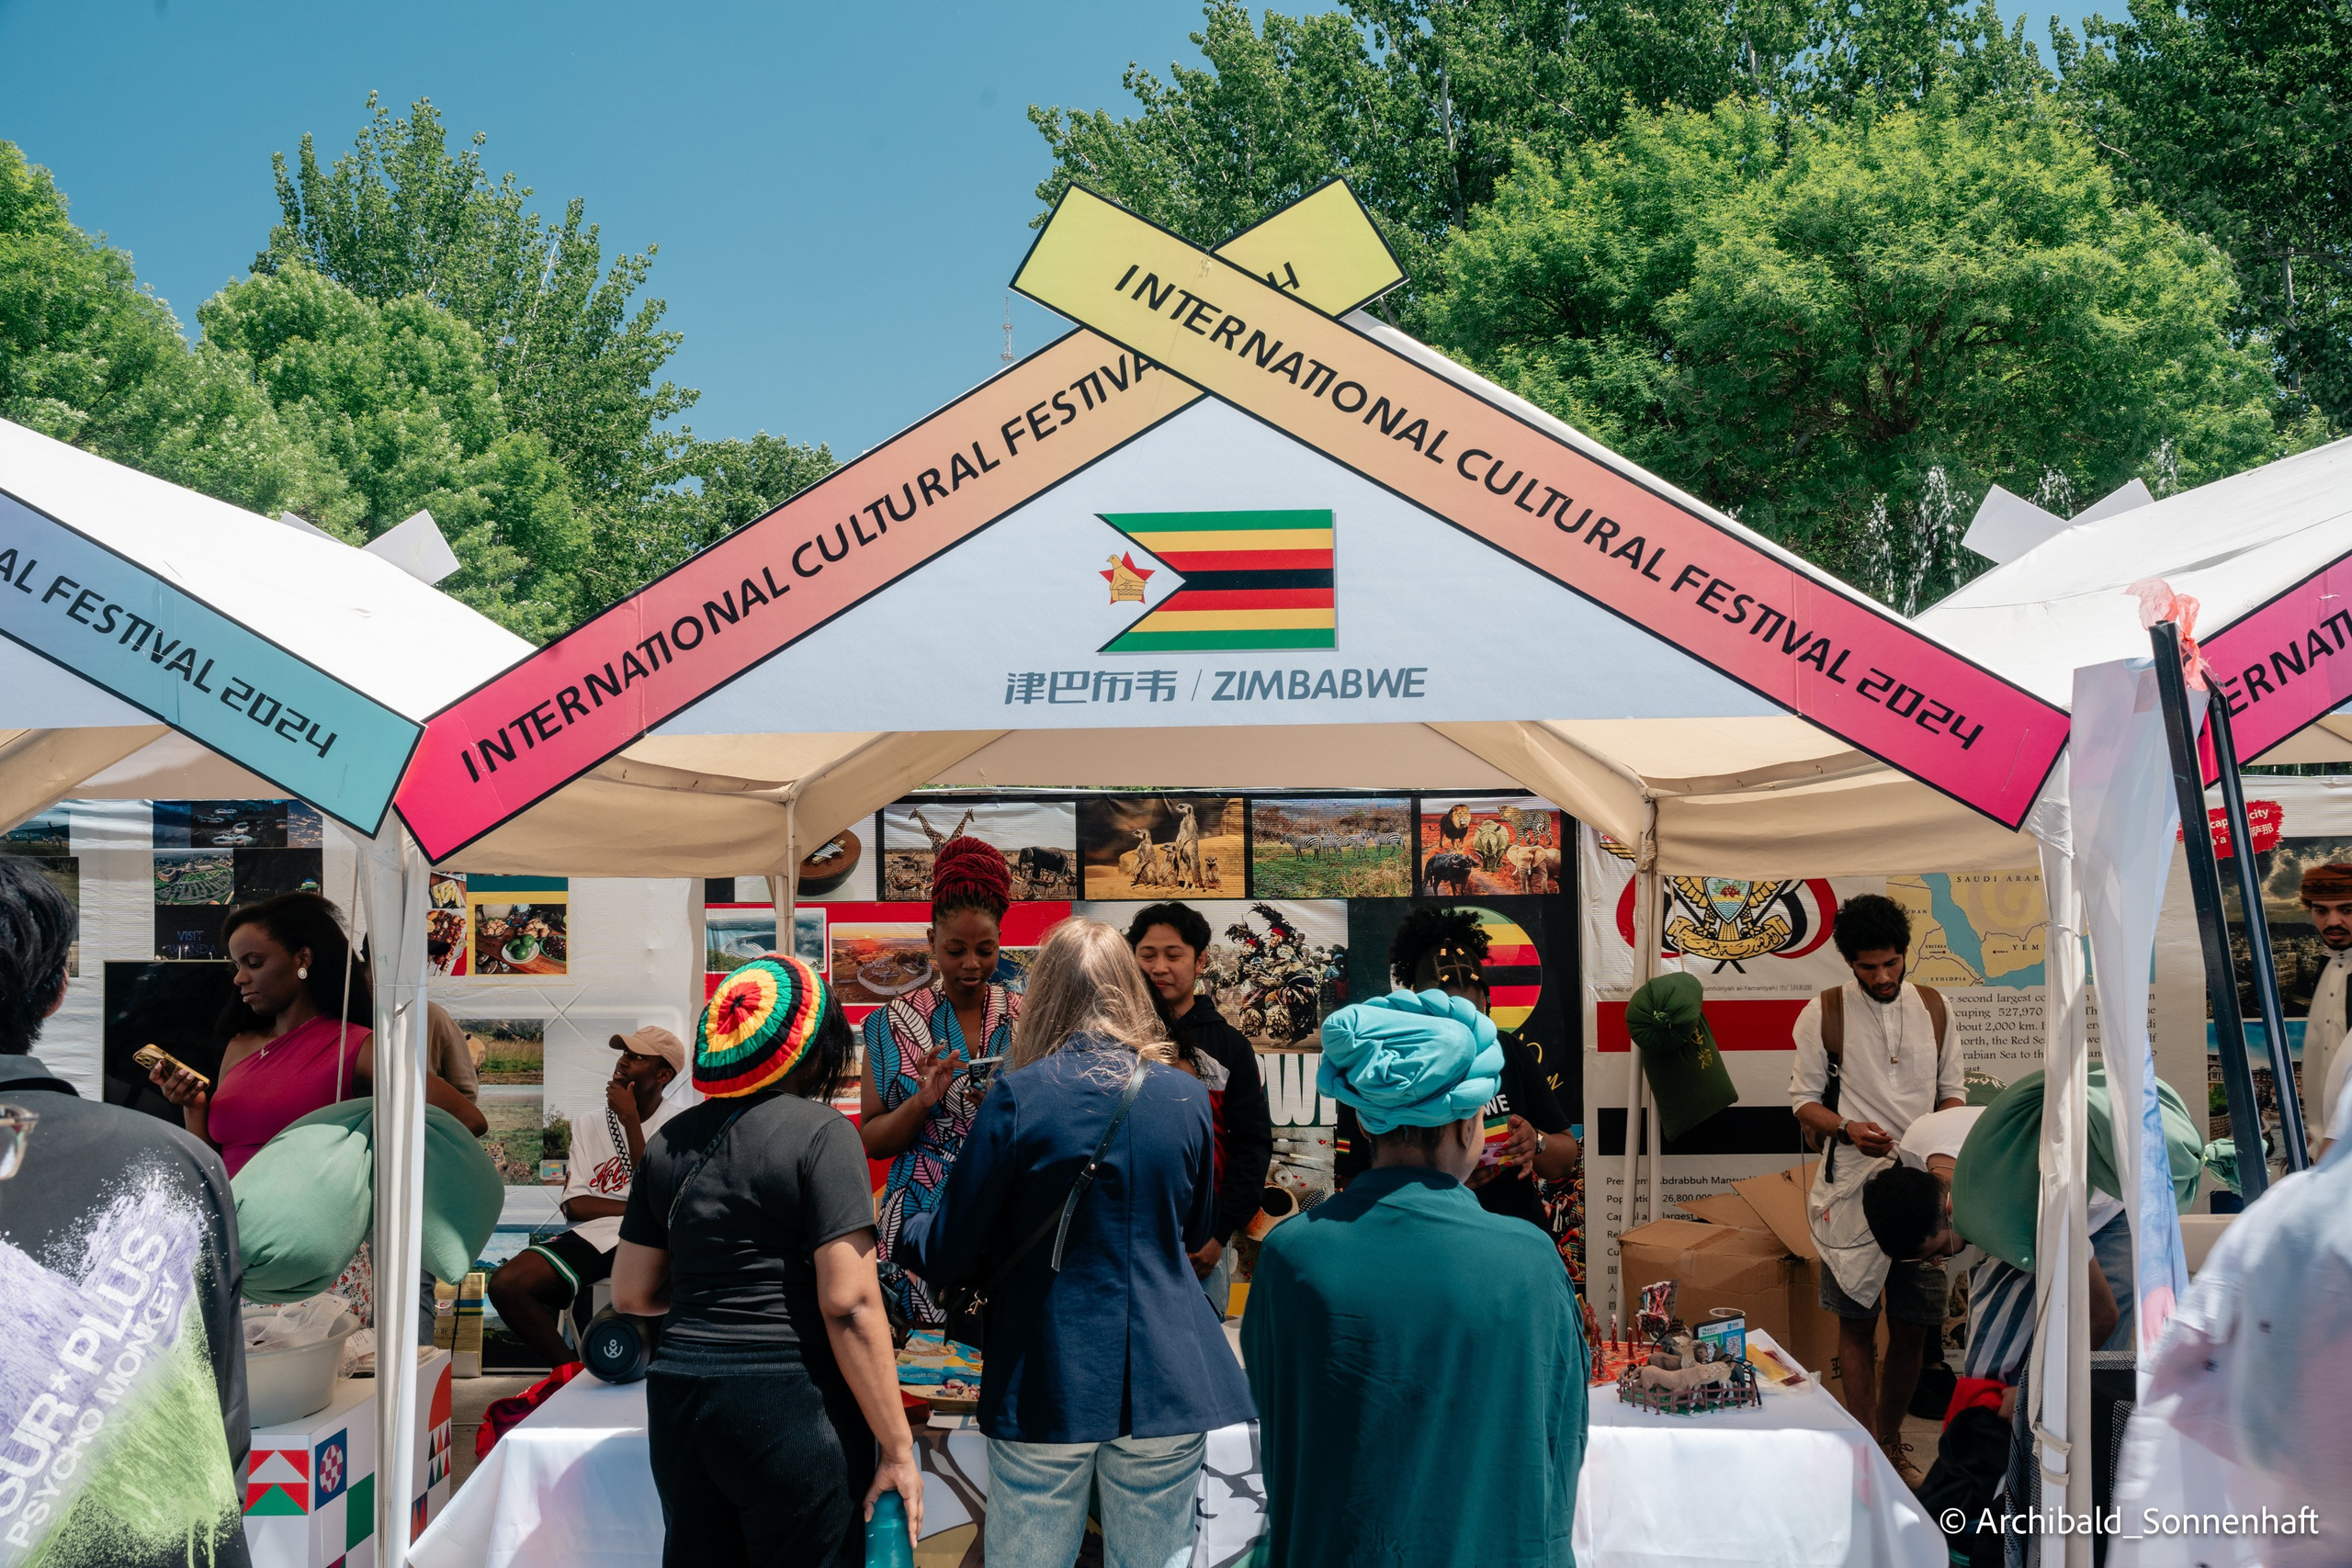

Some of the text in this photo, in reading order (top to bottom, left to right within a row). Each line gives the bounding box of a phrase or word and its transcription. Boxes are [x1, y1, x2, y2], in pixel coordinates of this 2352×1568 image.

[1114, 265, 1984, 750] INTERNATIONAL CULTURAL FESTIVAL 2024
[461, 353, 1163, 784] INTERNATIONAL CULTURAL FESTIVA
[41, 575, 215, 694] FESTIVAL
[220, 676, 338, 759] 2024
[1004, 671, 1178, 705] 津巴布韦
[1211, 668, 1429, 702] ZIMBABWE
[2248, 808, 2268, 820] city
[1957, 993, 1993, 1003] second
[1996, 993, 2031, 1004] largest
[1953, 1007, 2043, 1019] cuping 527,970
[1984, 1021, 2016, 1032] 2,000
[2018, 1021, 2038, 1031] km.
[1992, 1035, 2008, 1045] the
[2011, 1035, 2030, 1045] Red
[2032, 1035, 2046, 1044] Se
[1962, 1049, 2044, 1060] rabian Sea to th
[1660, 1176, 1708, 1185] bdrabbuh
[60, 1227, 168, 1377] PLUS
[5, 1269, 181, 1549] PSYCHO MONKEY
